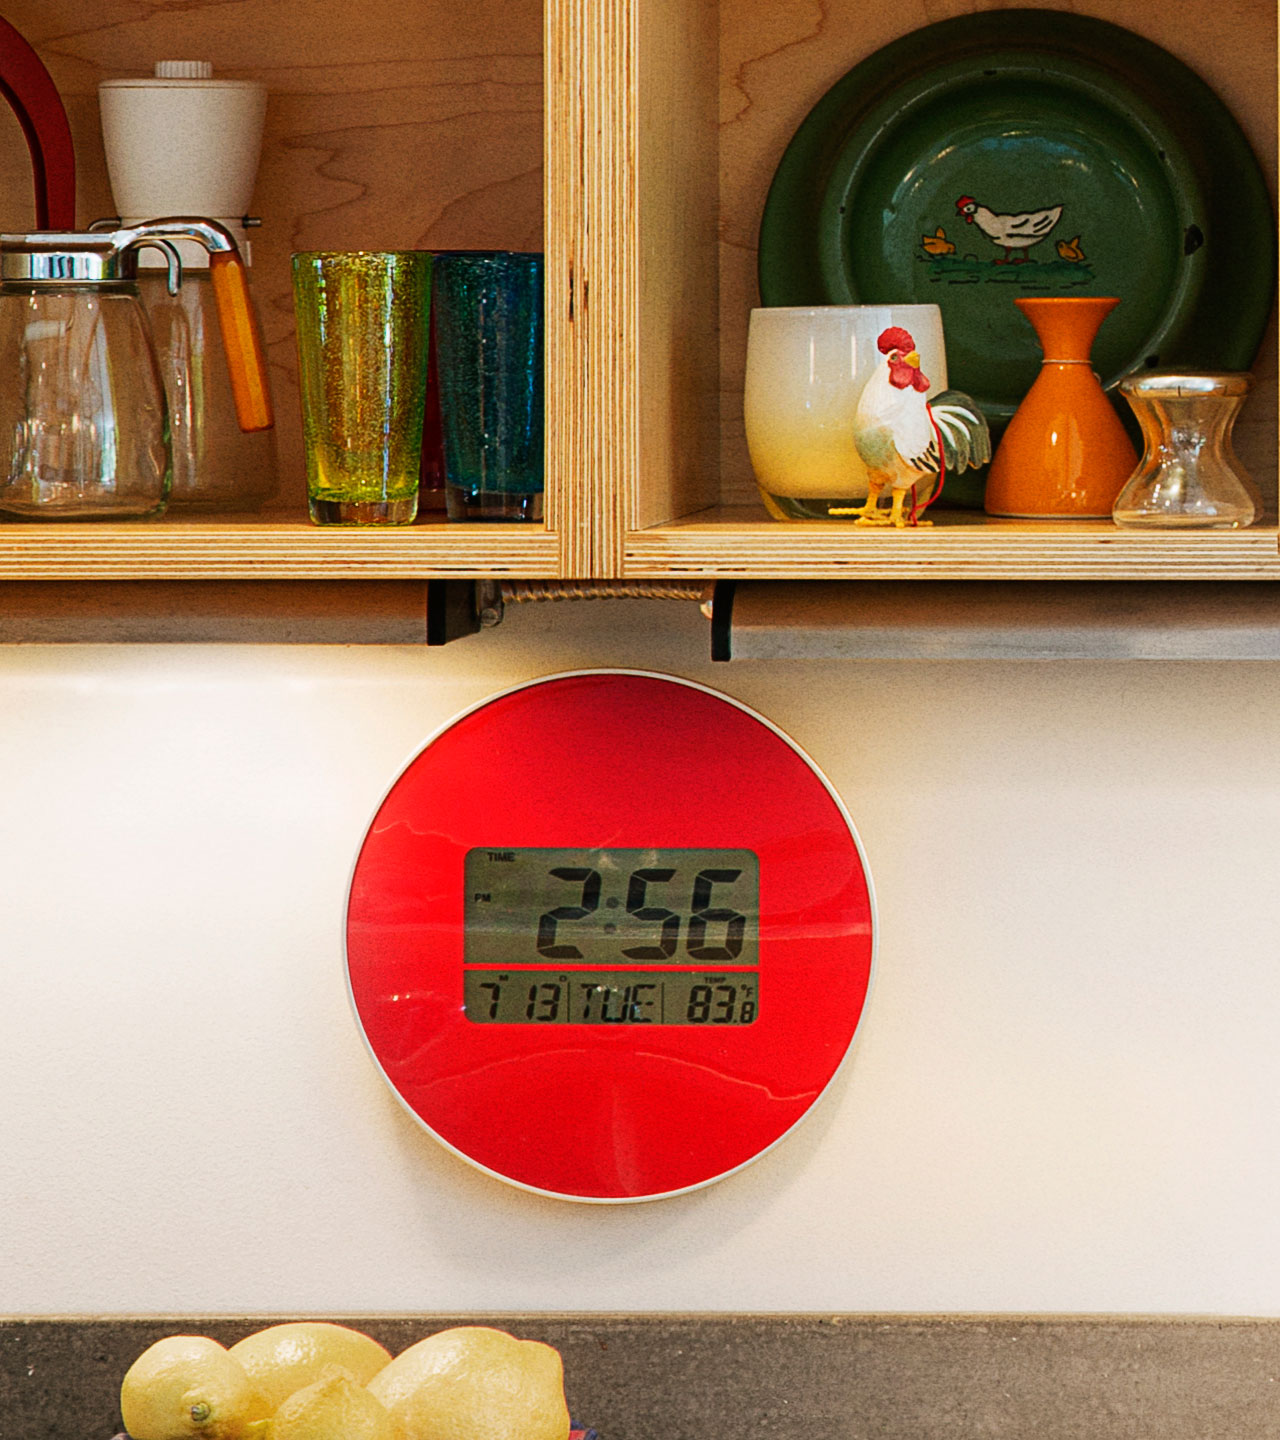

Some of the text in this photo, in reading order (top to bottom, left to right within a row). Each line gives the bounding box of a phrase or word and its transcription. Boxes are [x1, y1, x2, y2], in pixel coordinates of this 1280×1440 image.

[487, 852, 516, 863] TIME
[474, 893, 491, 903] PM
[536, 866, 747, 961] 2:56
[479, 983, 560, 1022] 7 13
[580, 983, 656, 1024] TUE
